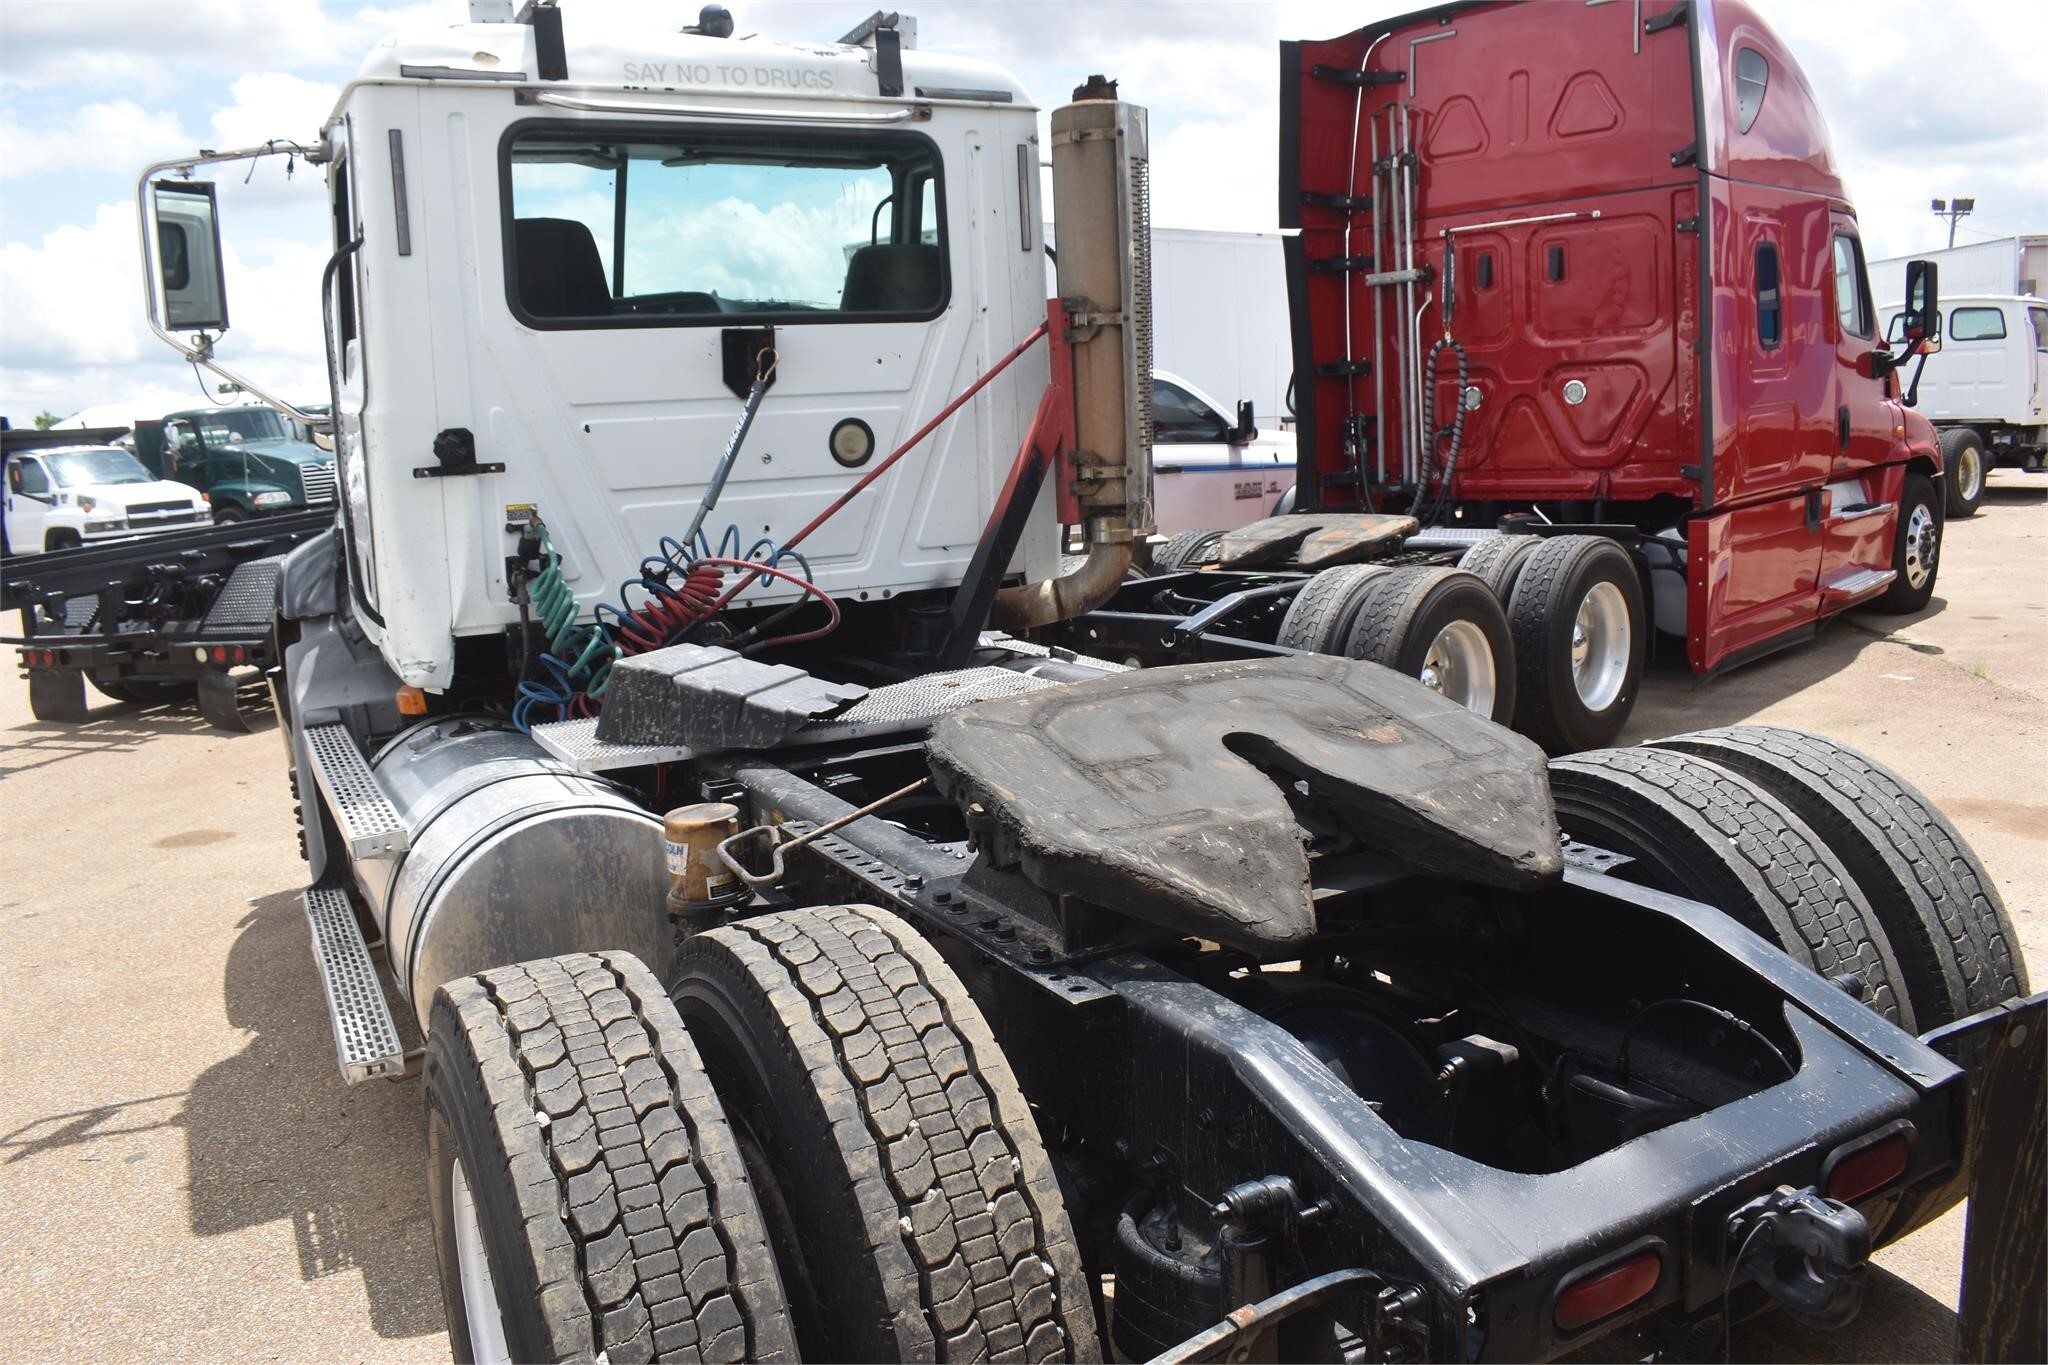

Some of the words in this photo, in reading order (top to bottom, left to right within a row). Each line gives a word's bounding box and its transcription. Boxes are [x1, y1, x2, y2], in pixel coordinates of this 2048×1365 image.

[623, 62, 667, 82] SAY
[677, 64, 711, 84] NO
[716, 66, 748, 85] TO
[754, 68, 833, 89] DRUGS
